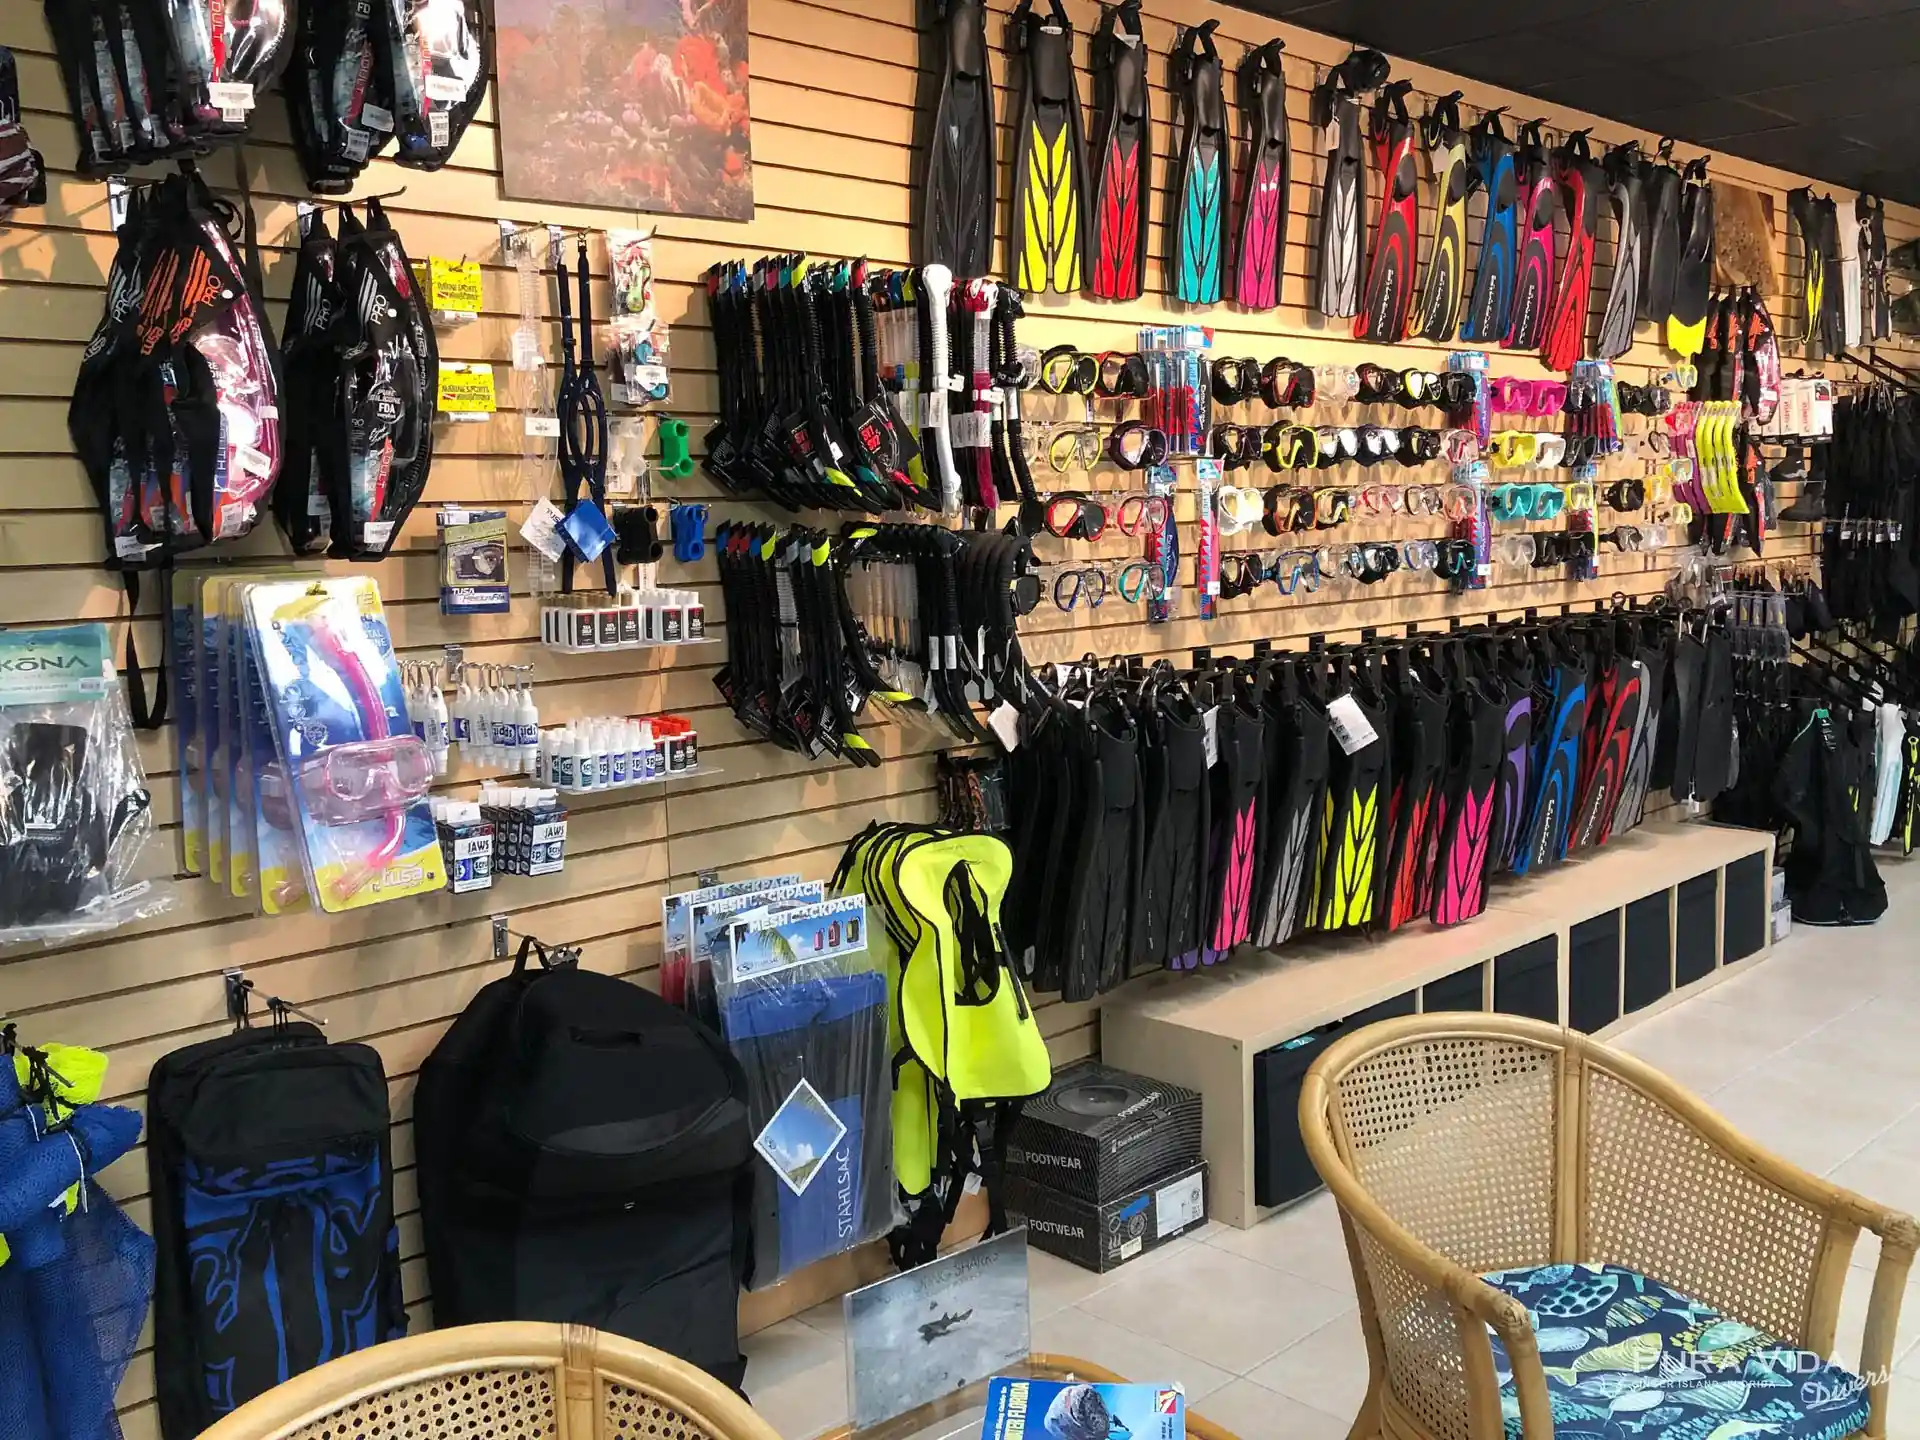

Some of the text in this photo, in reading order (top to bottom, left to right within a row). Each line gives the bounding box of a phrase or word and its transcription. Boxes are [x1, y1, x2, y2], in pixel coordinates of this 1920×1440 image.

[210, 0, 223, 42] DULT
[202, 275, 222, 307] PRO
[314, 298, 332, 330] PRO
[371, 294, 387, 325] PRO
[378, 402, 396, 413] FDA
[376, 446, 393, 489] ADULT
[545, 507, 561, 523] TUS
[451, 587, 476, 597] TUSA
[544, 825, 565, 839] JAWS
[468, 840, 489, 853] JAWS
[382, 864, 424, 888] tusa
[681, 888, 719, 906] MESH
[707, 897, 747, 915] MESH
[748, 913, 789, 934] MESH
[1025, 1151, 1082, 1170] FOOTWEAR
[835, 1148, 853, 1238] STAHLSAC
[1029, 1219, 1085, 1239] FOOTWEAR
[1007, 1382, 1030, 1418] FLORIDA
